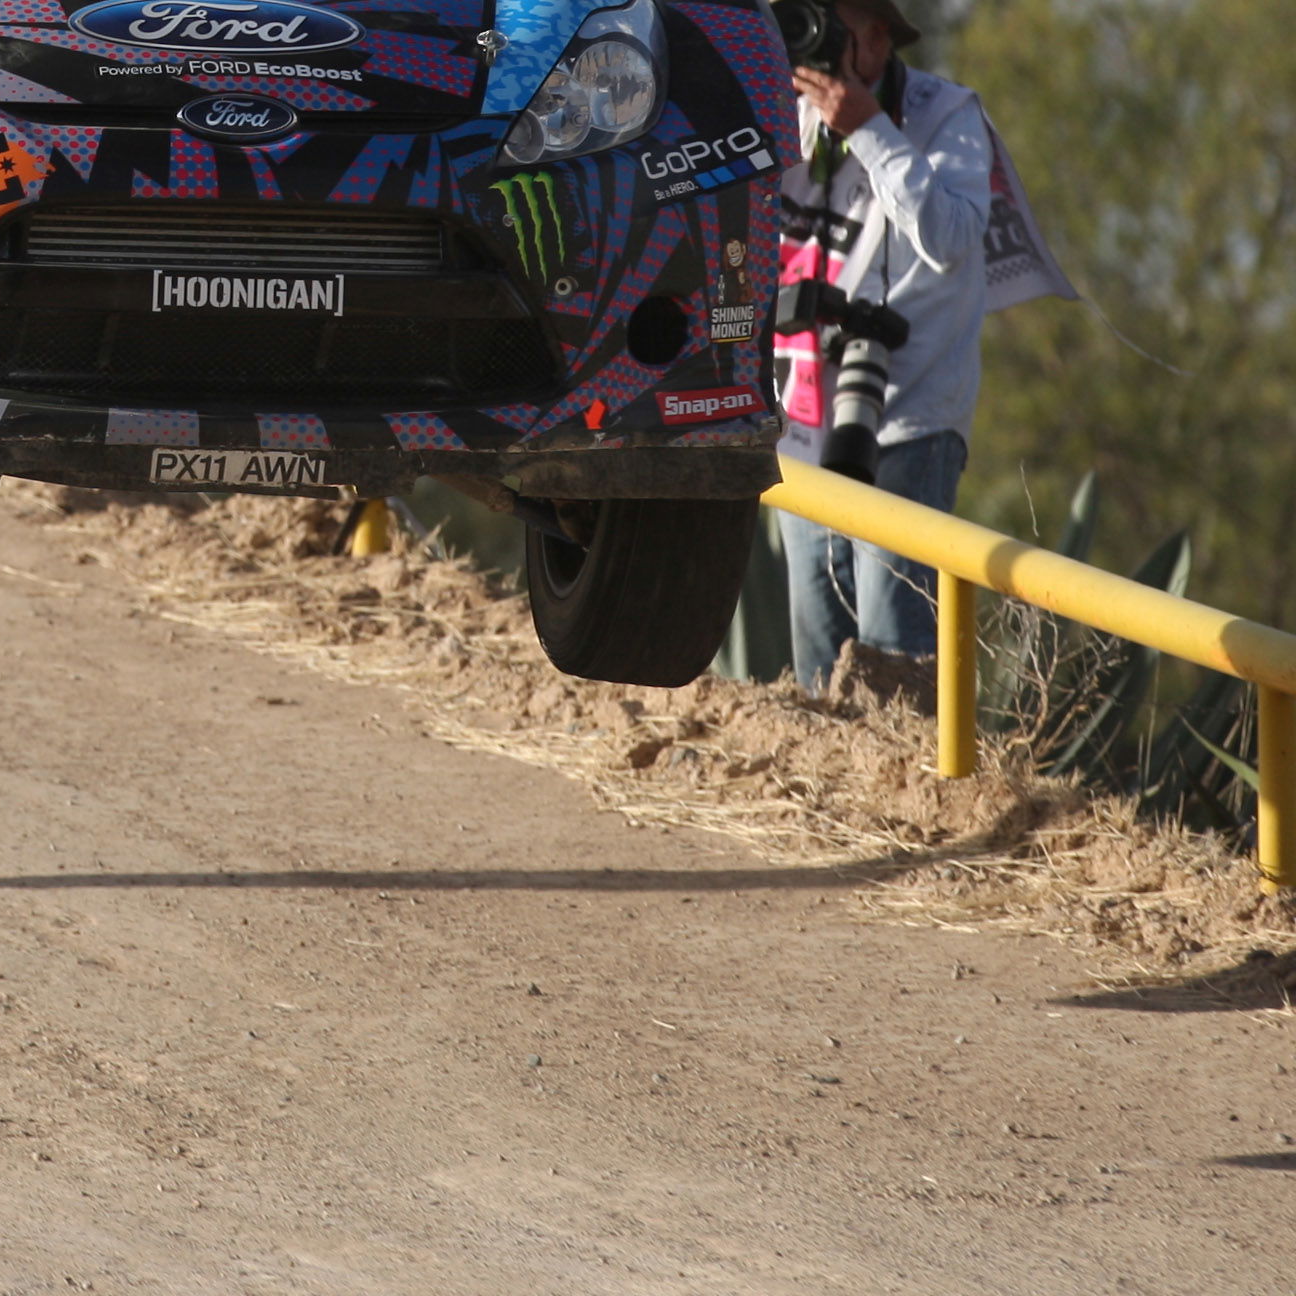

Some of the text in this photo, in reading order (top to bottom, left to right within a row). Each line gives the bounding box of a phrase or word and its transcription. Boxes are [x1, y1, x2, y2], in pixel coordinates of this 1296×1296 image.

[129, 0, 308, 43] Ford
[99, 60, 363, 82] Powered by FORD EcoBoost
[206, 101, 271, 128] Ford
[641, 127, 761, 179] GoPro
[654, 189, 666, 201] Be
[152, 269, 345, 316] [HOONIGAN]
[711, 305, 755, 323] SHINING
[711, 322, 754, 339] MONKEY
[664, 393, 754, 416] Snap-on
[155, 453, 326, 484] PX11 AWN
